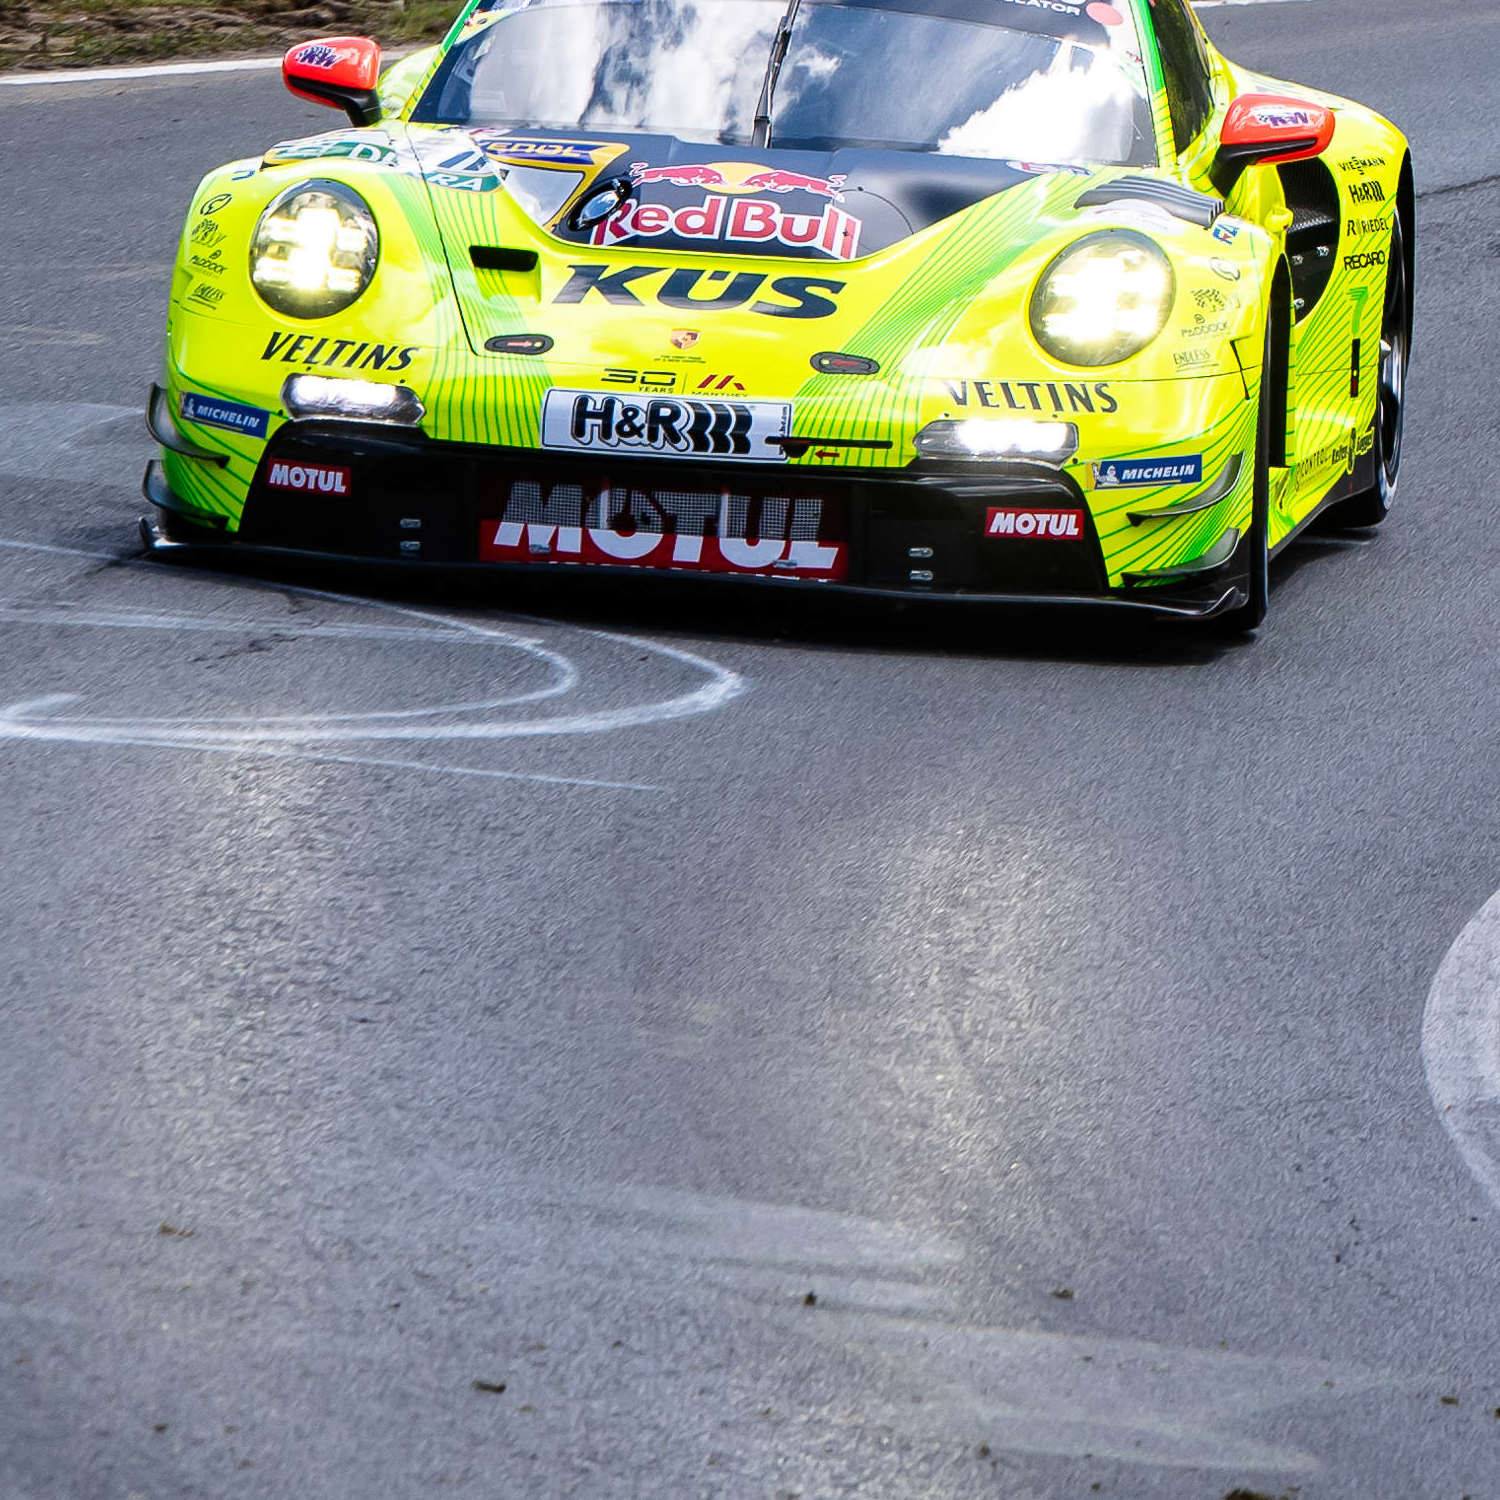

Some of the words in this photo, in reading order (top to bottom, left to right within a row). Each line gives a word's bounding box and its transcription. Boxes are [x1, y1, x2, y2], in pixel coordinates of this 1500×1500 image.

[590, 195, 727, 246] Red
[725, 199, 862, 261] Bull
[1361, 217, 1389, 235] RIEDEL
[1343, 250, 1386, 271] RECARO
[552, 264, 848, 319] KÜS
[261, 331, 420, 371] VELTINS
[601, 367, 677, 387] 30
[638, 386, 674, 395] YEARS
[941, 380, 1119, 413] VELTINS
[196, 404, 261, 429] MICHELIN
[571, 394, 691, 453] H&R
[269, 463, 347, 494] MOTUL
[1121, 463, 1196, 481] MICHELIN
[494, 480, 839, 570] MOTUL
[989, 512, 1080, 536] MOTUL
